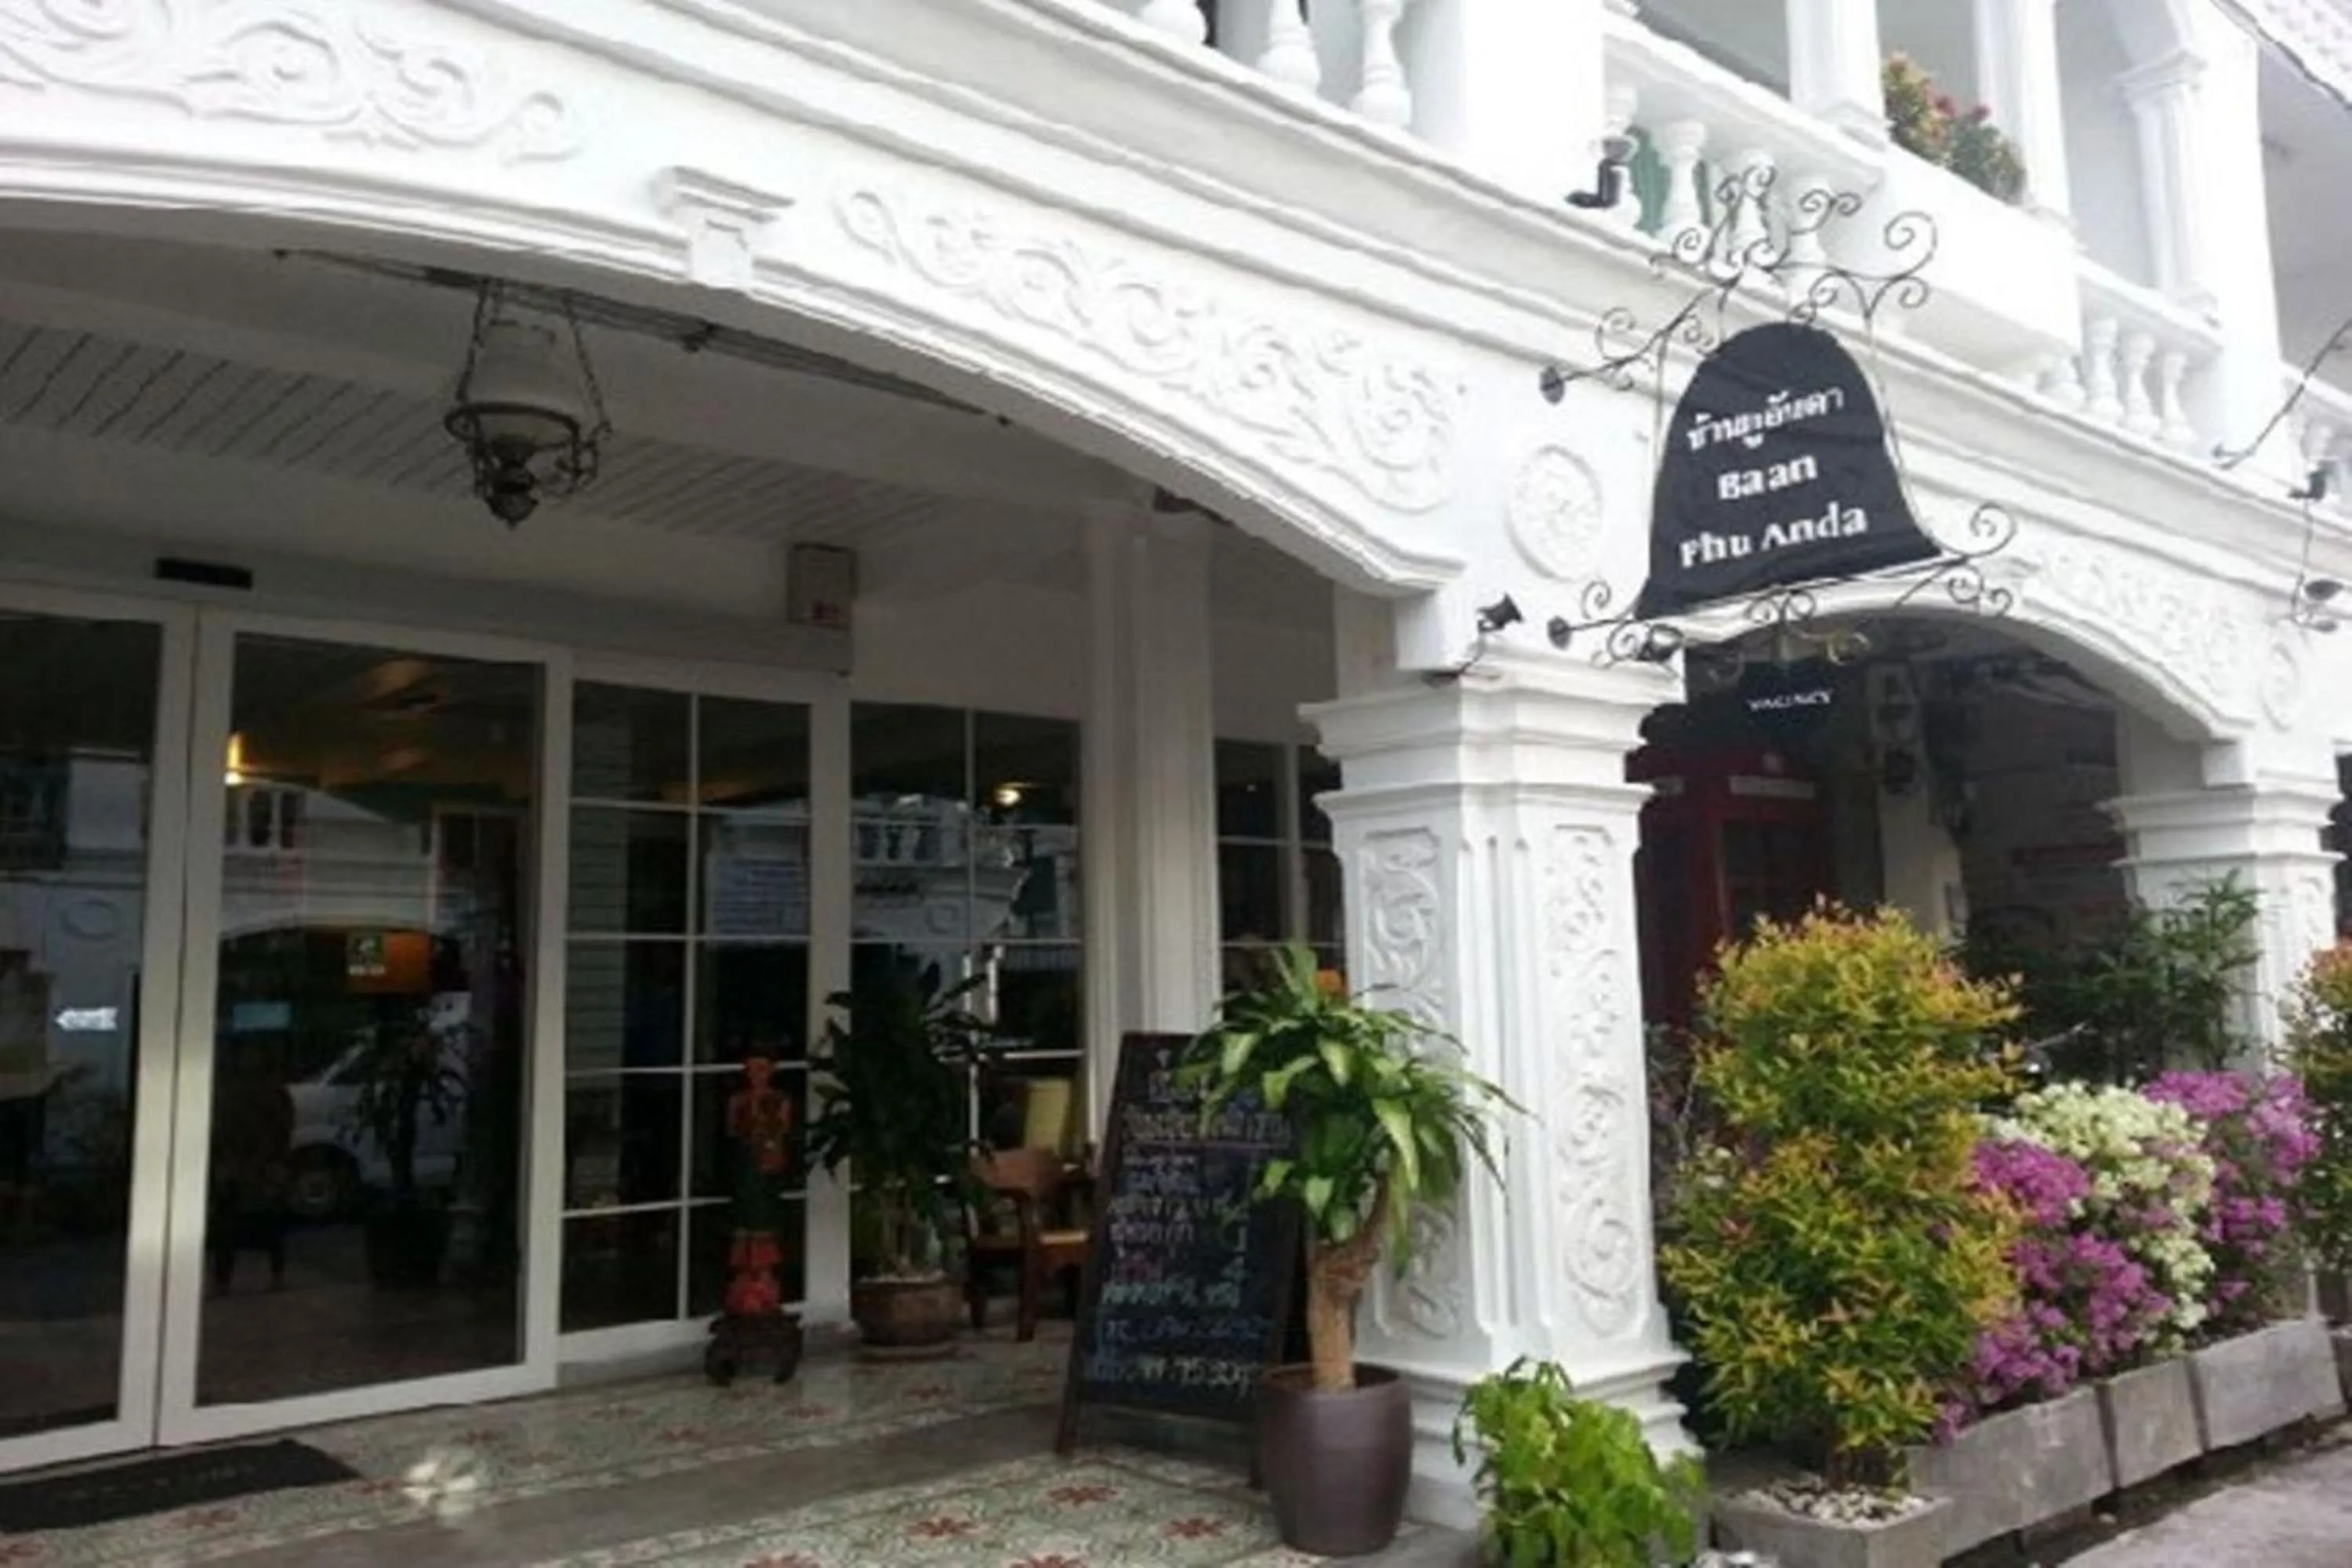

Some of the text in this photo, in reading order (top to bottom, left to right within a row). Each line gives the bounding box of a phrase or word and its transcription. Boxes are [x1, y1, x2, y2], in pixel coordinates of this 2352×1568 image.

[1717, 455, 1819, 500] Baan
[1679, 500, 1868, 569] Phu Anda
